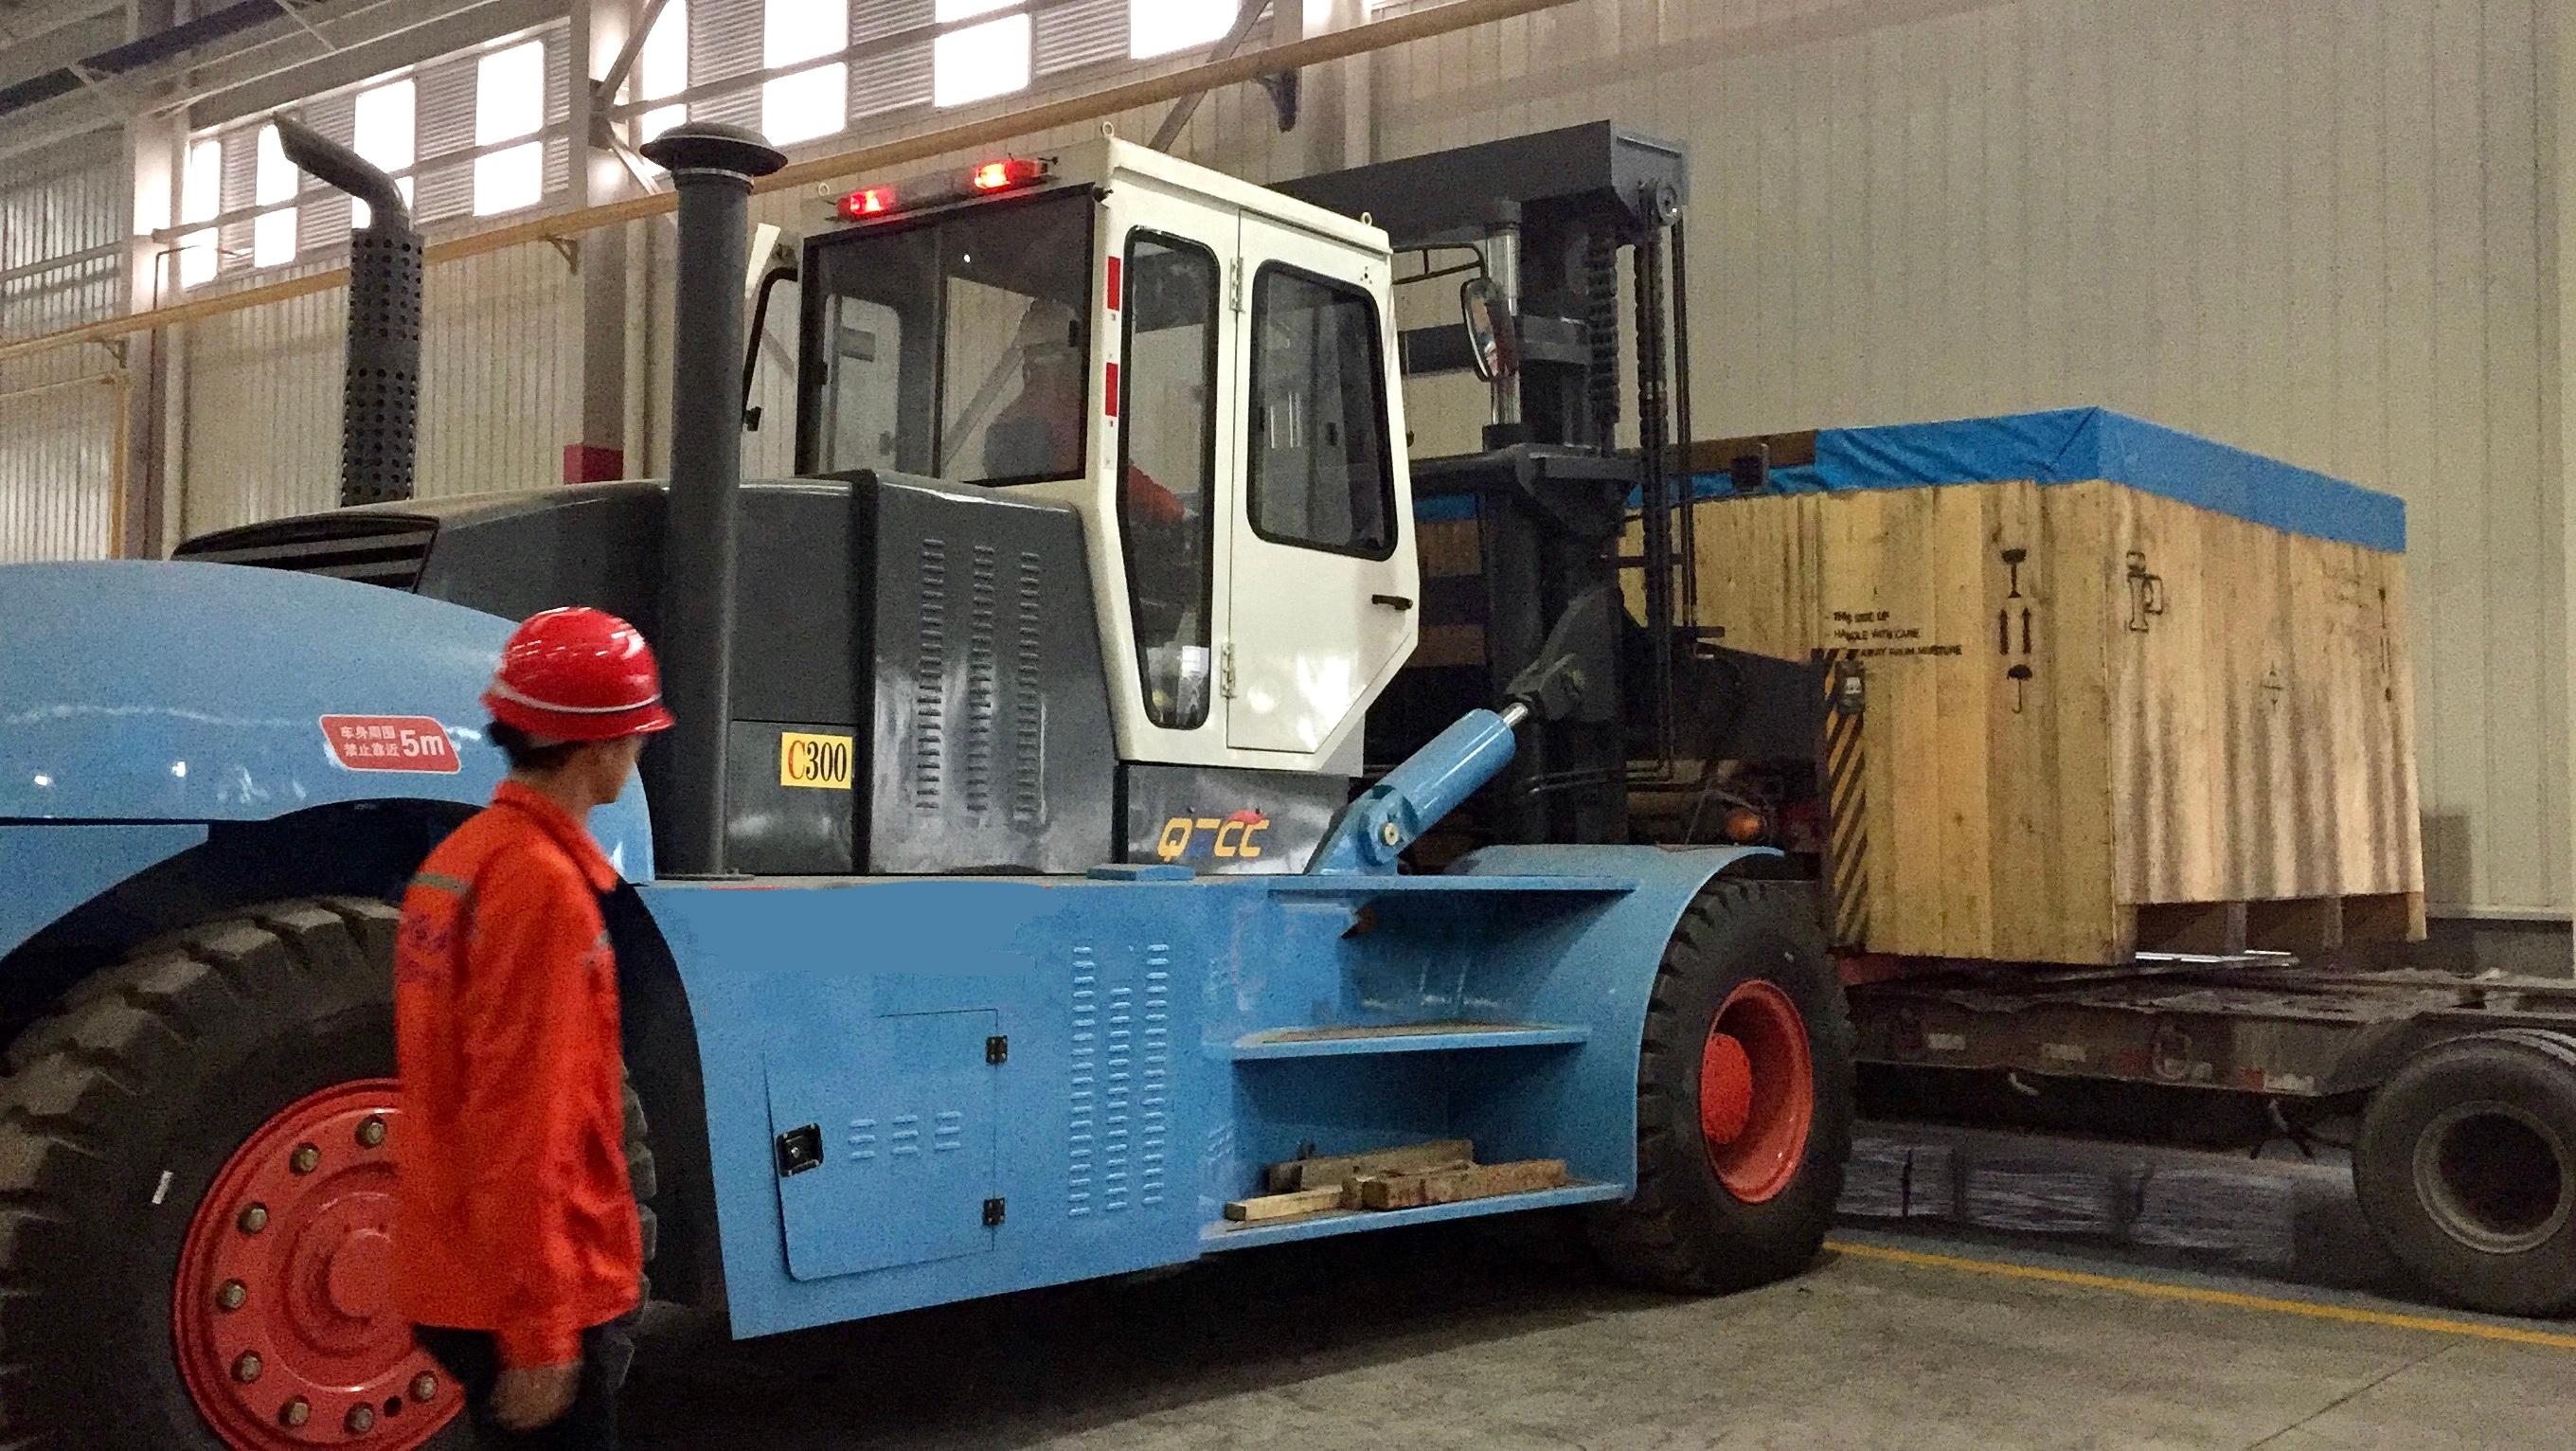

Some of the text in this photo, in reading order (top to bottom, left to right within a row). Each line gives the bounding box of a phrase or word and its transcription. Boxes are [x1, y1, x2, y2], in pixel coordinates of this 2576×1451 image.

[343, 743, 400, 757] 禁止靠近
[400, 729, 445, 757] 5m
[788, 740, 847, 782] C300
